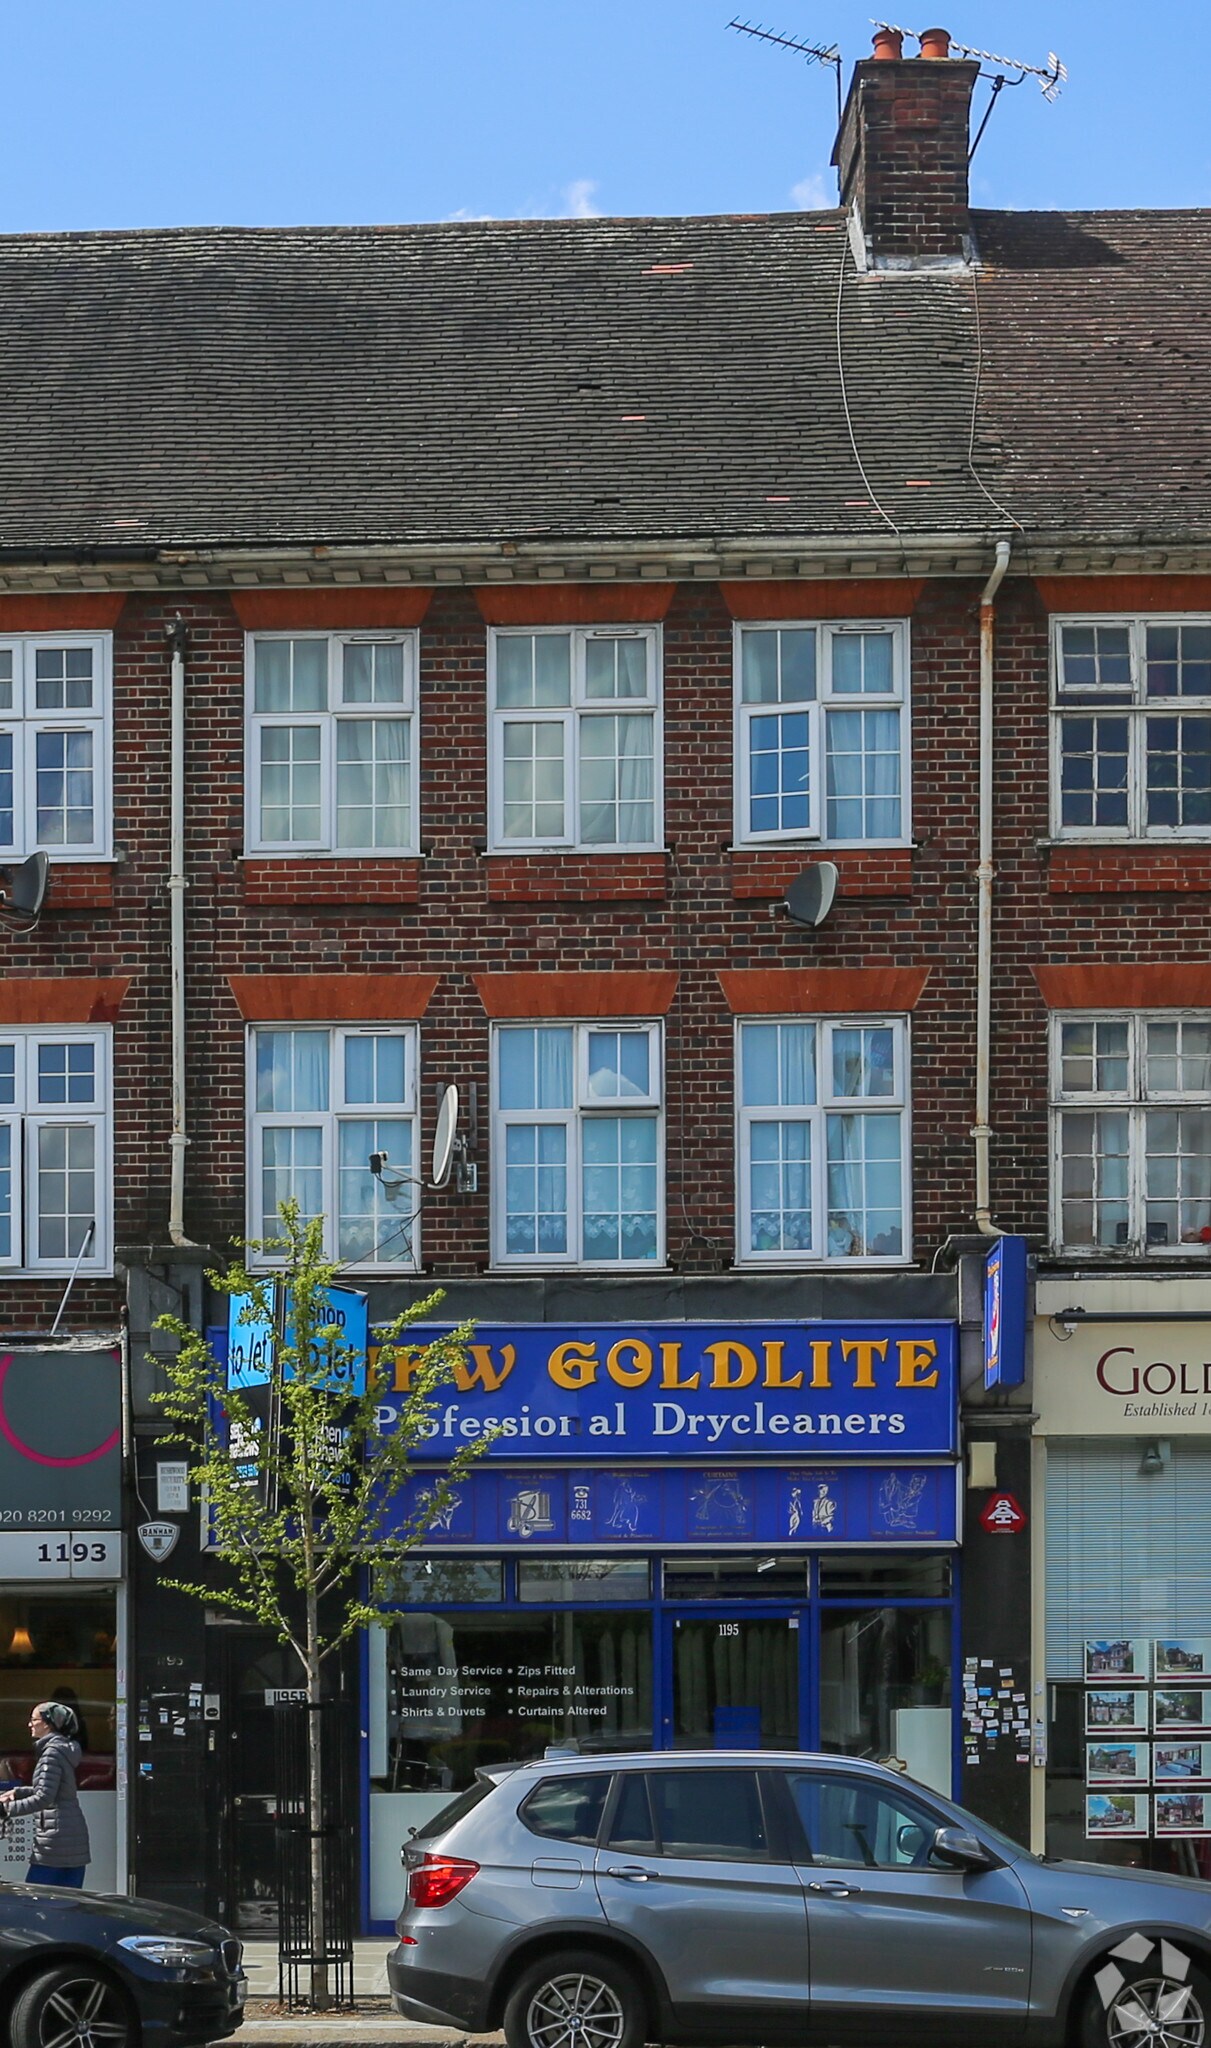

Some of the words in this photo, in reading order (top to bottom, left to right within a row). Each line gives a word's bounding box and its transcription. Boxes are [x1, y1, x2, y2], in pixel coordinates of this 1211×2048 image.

[248, 1330, 269, 1373] let
[548, 1338, 939, 1391] GOLDLITE
[1096, 1346, 1211, 1395] GOL
[1123, 1402, 1197, 1417] Established
[653, 1402, 905, 1442] Drycleaners
[575, 1499, 588, 1510] 731
[0, 1510, 22, 1522] 20
[27, 1510, 65, 1522] 8201
[72, 1510, 112, 1522] 9292
[571, 1510, 592, 1521] 6682
[142, 1528, 173, 1537] BANHAM
[38, 1543, 107, 1562] 1193
[719, 1624, 739, 1636] 1195
[401, 1667, 432, 1676] Same
[437, 1666, 459, 1678] Day
[462, 1665, 502, 1675] Service
[517, 1666, 541, 1677] Zips
[544, 1665, 576, 1675] Fitted
[402, 1687, 447, 1698] Laundry
[450, 1686, 491, 1696] Service
[517, 1686, 559, 1697] Repairs
[562, 1686, 570, 1695] &
[574, 1685, 634, 1695] Alterations
[401, 1707, 433, 1717] Shirts
[436, 1707, 444, 1716] &
[448, 1707, 486, 1716] Duvets
[518, 1706, 564, 1716] Curtains
[567, 1706, 607, 1715] Altered
[8, 1836, 25, 1844] 9.00
[8, 1845, 25, 1853] 9.00
[4, 1854, 25, 1862] 10.00
